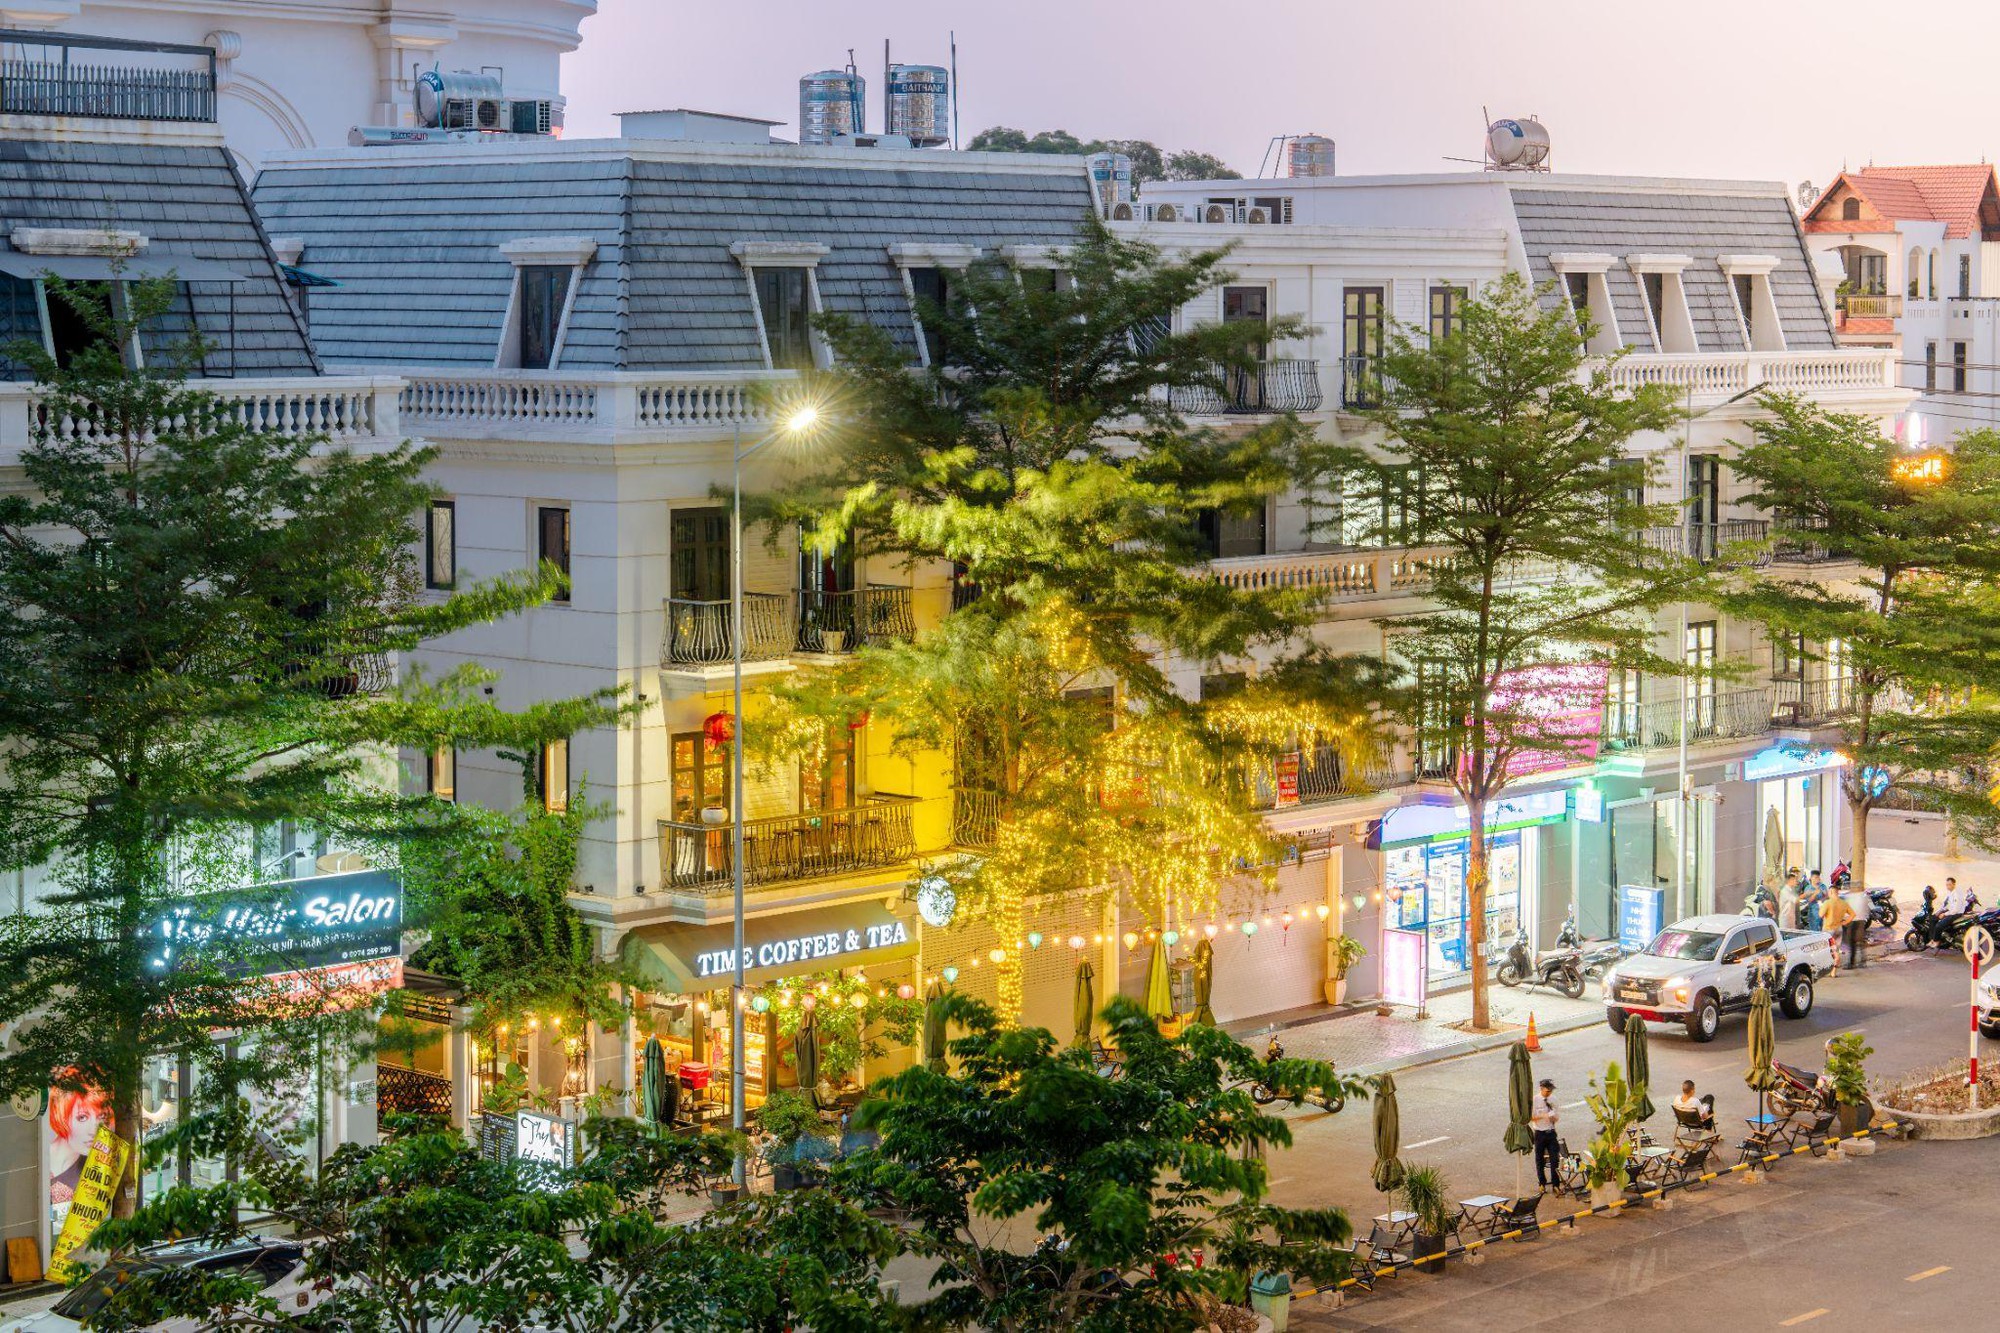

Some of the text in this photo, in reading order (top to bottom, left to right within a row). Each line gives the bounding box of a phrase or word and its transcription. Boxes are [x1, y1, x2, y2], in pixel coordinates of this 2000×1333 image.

[303, 892, 396, 927] Salon
[697, 922, 907, 977] TIME COFFEE & TEA
